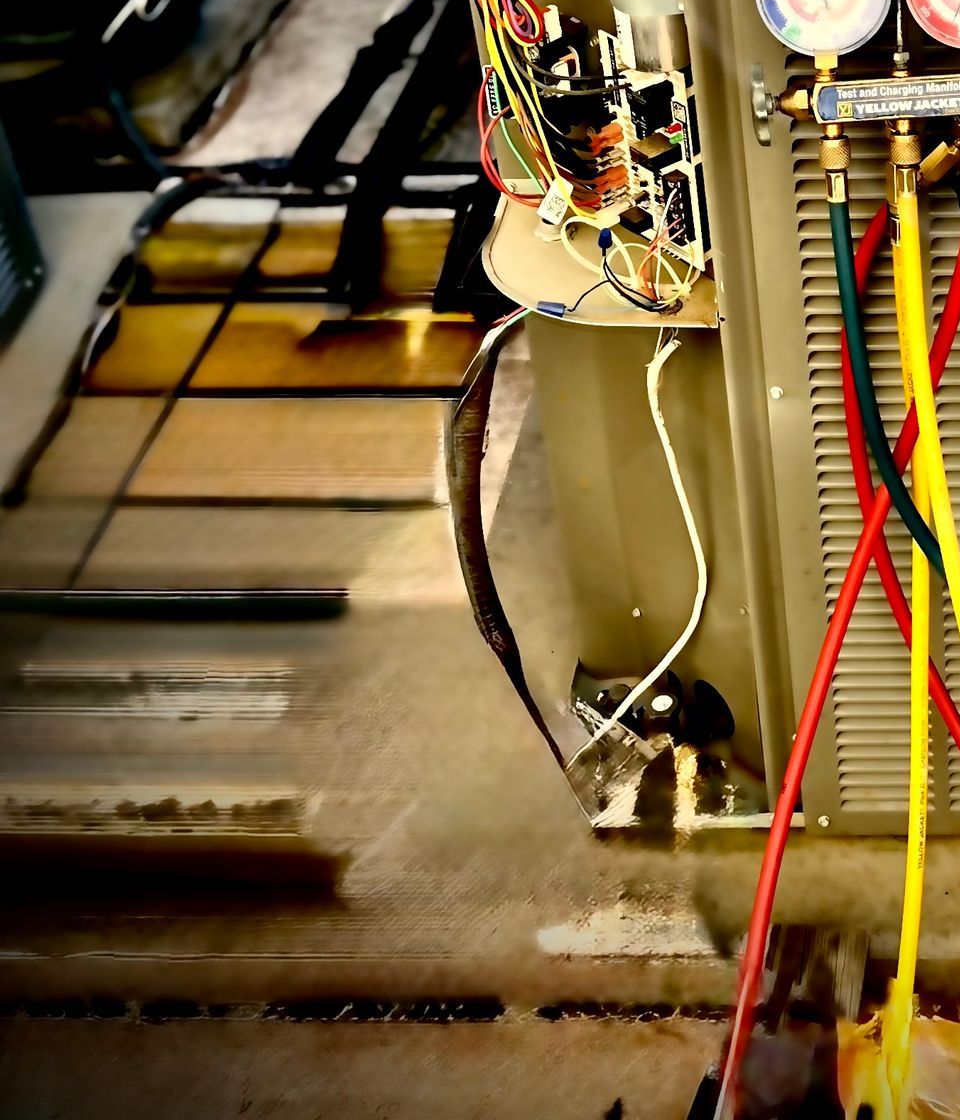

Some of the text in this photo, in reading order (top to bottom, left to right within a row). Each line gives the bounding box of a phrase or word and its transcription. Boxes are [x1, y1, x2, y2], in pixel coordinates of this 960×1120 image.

[836, 88, 858, 100] Test
[858, 85, 878, 98] and
[879, 82, 924, 97] Charging
[855, 101, 913, 115] YELLOW
